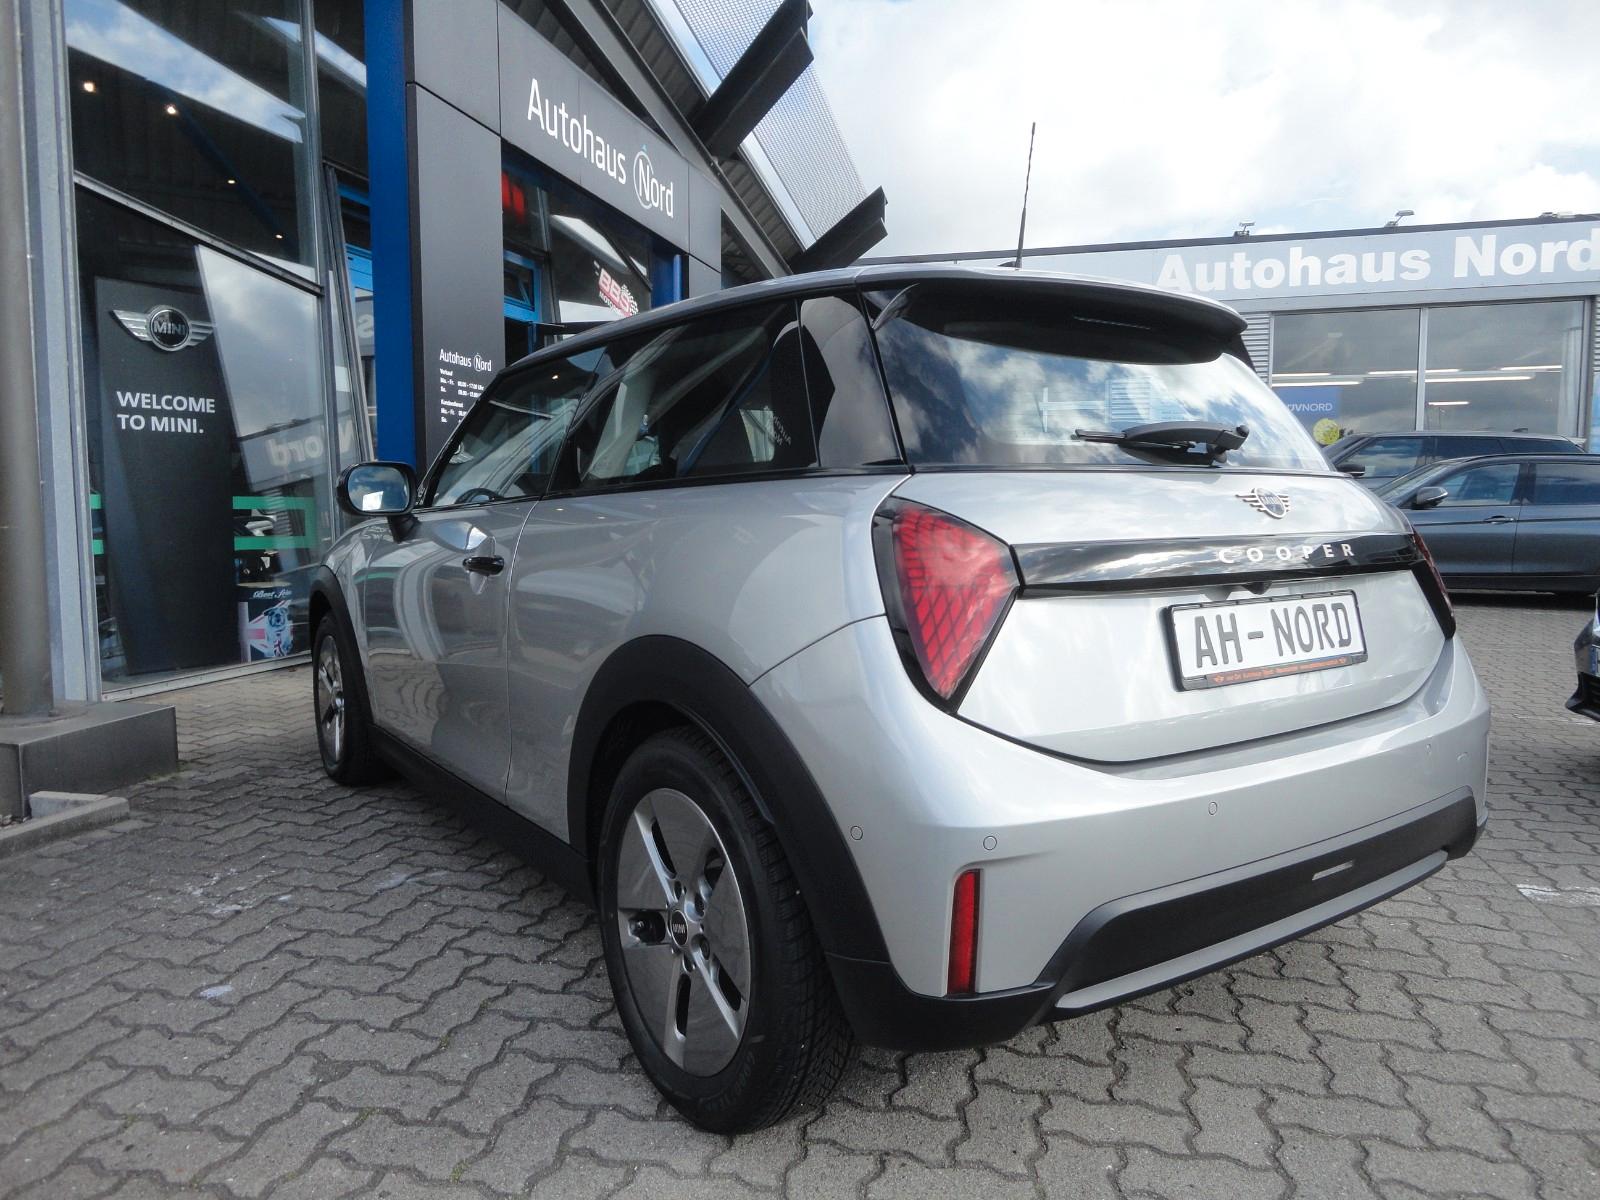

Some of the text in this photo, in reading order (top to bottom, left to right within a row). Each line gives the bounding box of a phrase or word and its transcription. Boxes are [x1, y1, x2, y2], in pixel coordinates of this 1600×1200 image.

[527, 78, 674, 219] Autohaus Nord
[1156, 227, 1600, 292] Autohaus Nord
[153, 320, 187, 336] MINI
[439, 348, 492, 372] Autohaus Nord
[116, 390, 216, 413] WELCOME
[116, 413, 204, 434] TO MINI.
[1217, 543, 1356, 564] COOPER
